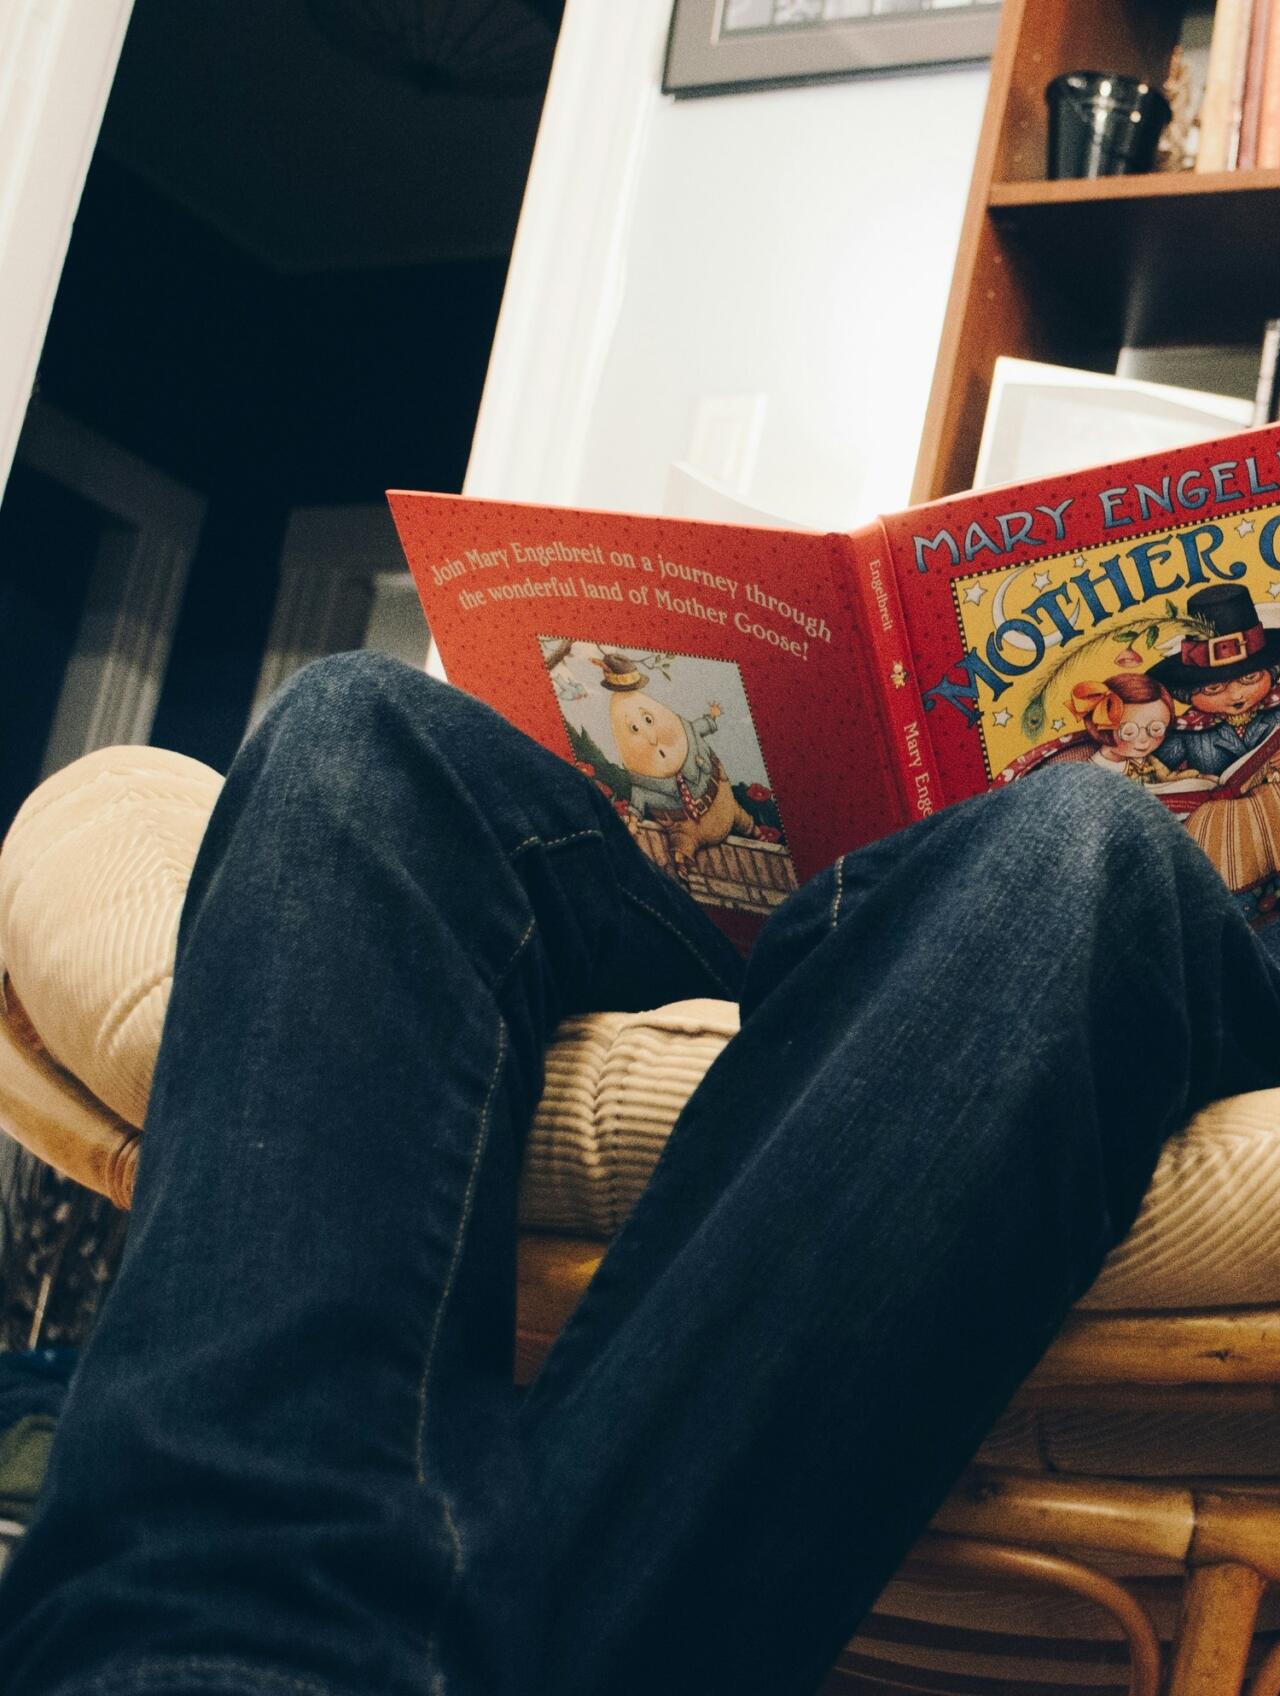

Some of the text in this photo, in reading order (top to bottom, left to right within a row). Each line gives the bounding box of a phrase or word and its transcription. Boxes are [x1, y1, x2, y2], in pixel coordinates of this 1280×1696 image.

[912, 497, 1076, 573] MARY
[431, 541, 833, 644] Join Mary Engelbreit on a journey through
[458, 576, 810, 661] the wonderful land of Mother Goose!
[868, 558, 893, 633] Engelbreit
[922, 523, 1247, 729] MOTHER
[903, 721, 923, 768] Mary
